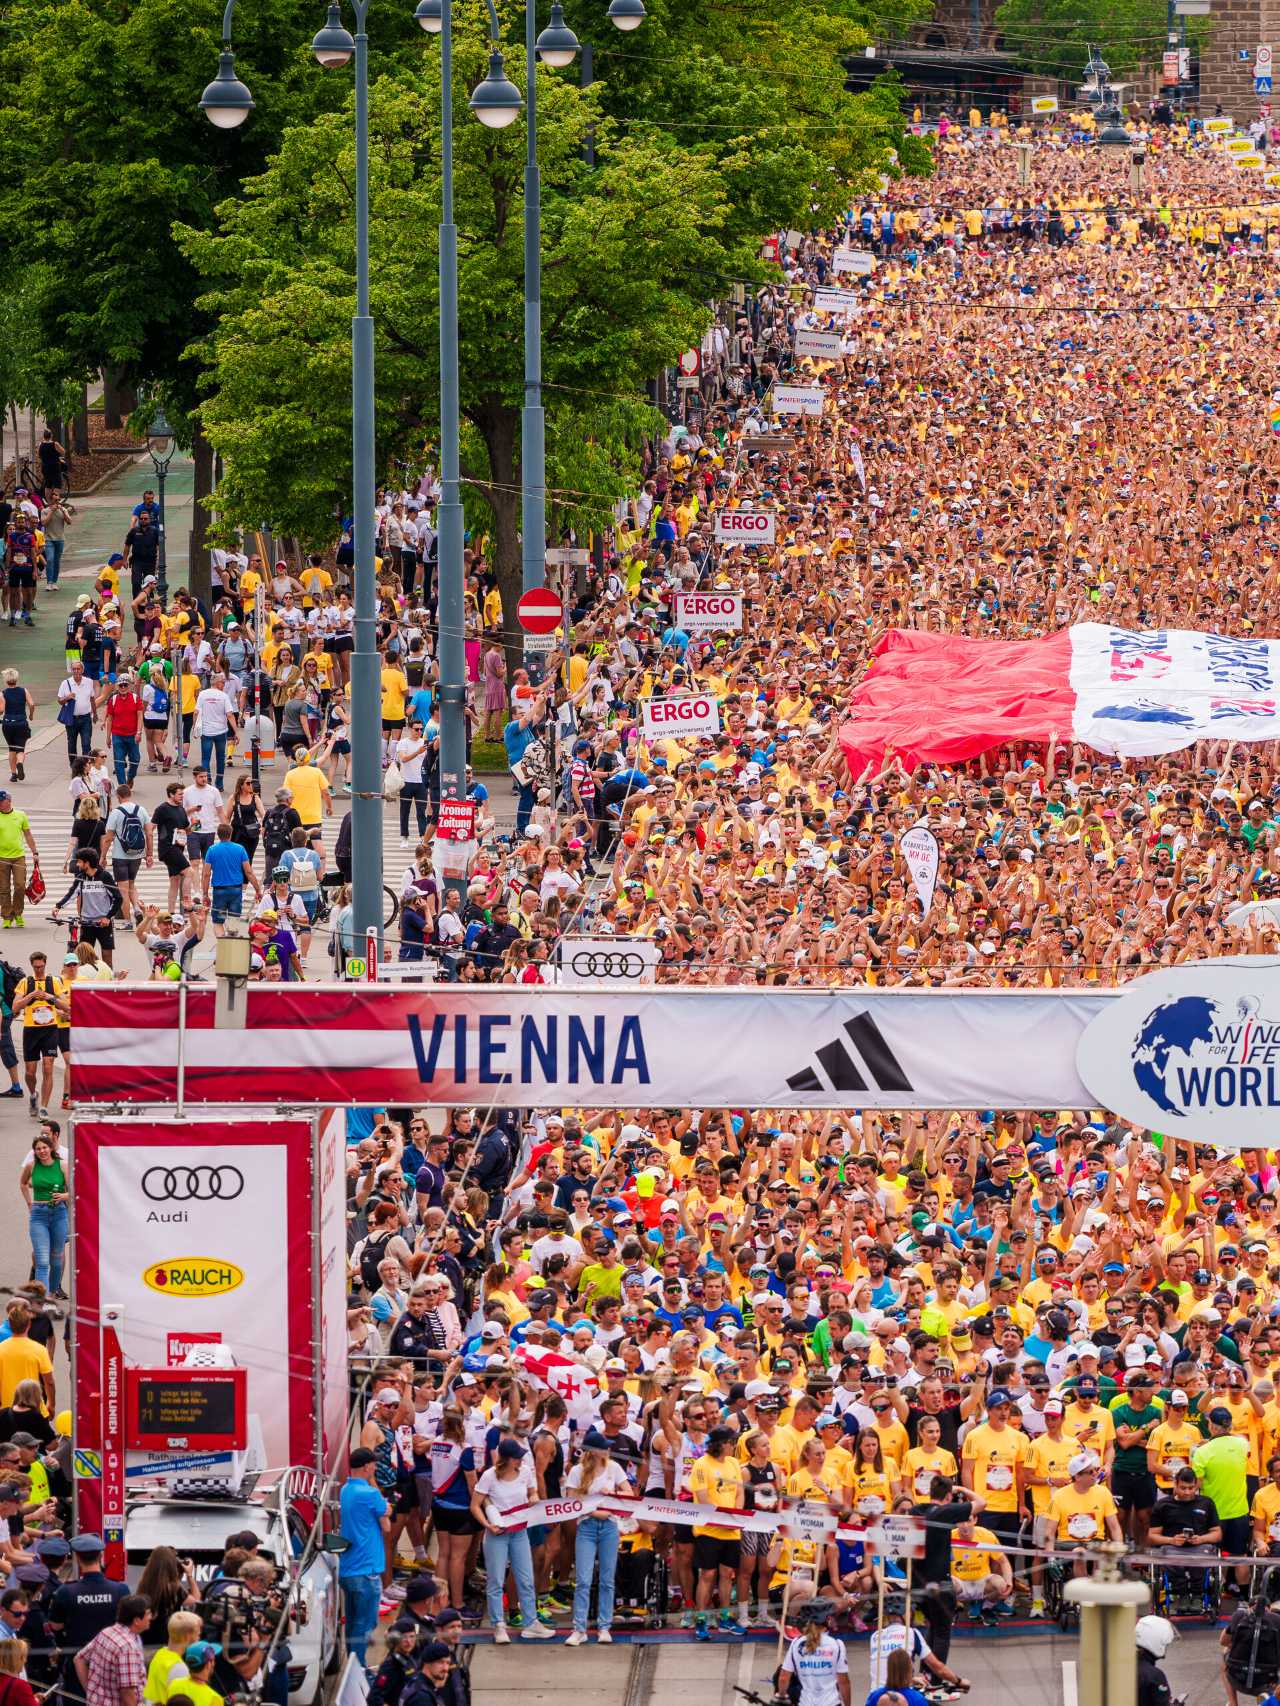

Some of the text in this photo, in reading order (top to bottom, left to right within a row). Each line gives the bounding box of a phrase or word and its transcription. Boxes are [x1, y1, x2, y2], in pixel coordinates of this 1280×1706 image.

[721, 515, 769, 531] ERGO
[684, 598, 735, 615] ERGO
[650, 700, 710, 723] ERGO
[439, 803, 473, 817] Kronen
[438, 816, 472, 830] Zeitung
[406, 1014, 652, 1084] VIENNA
[1208, 1045, 1227, 1056] FOR
[1226, 1045, 1280, 1065] LIFE
[146, 1211, 188, 1223] Audi
[170, 1269, 232, 1286] RAUCH
[108, 1356, 118, 1435] WIENER LINIEN
[110, 1473, 116, 1482] 1
[107, 1486, 119, 1495] 71
[109, 1501, 118, 1511] D
[545, 1500, 583, 1516] ERGO
[654, 1505, 700, 1518] INTERSPORT
[800, 1518, 824, 1528] WOMAN
[891, 1534, 906, 1542] MAN
[77, 1593, 112, 1605] POLIZEI
[799, 1660, 832, 1669] PHILIPS
